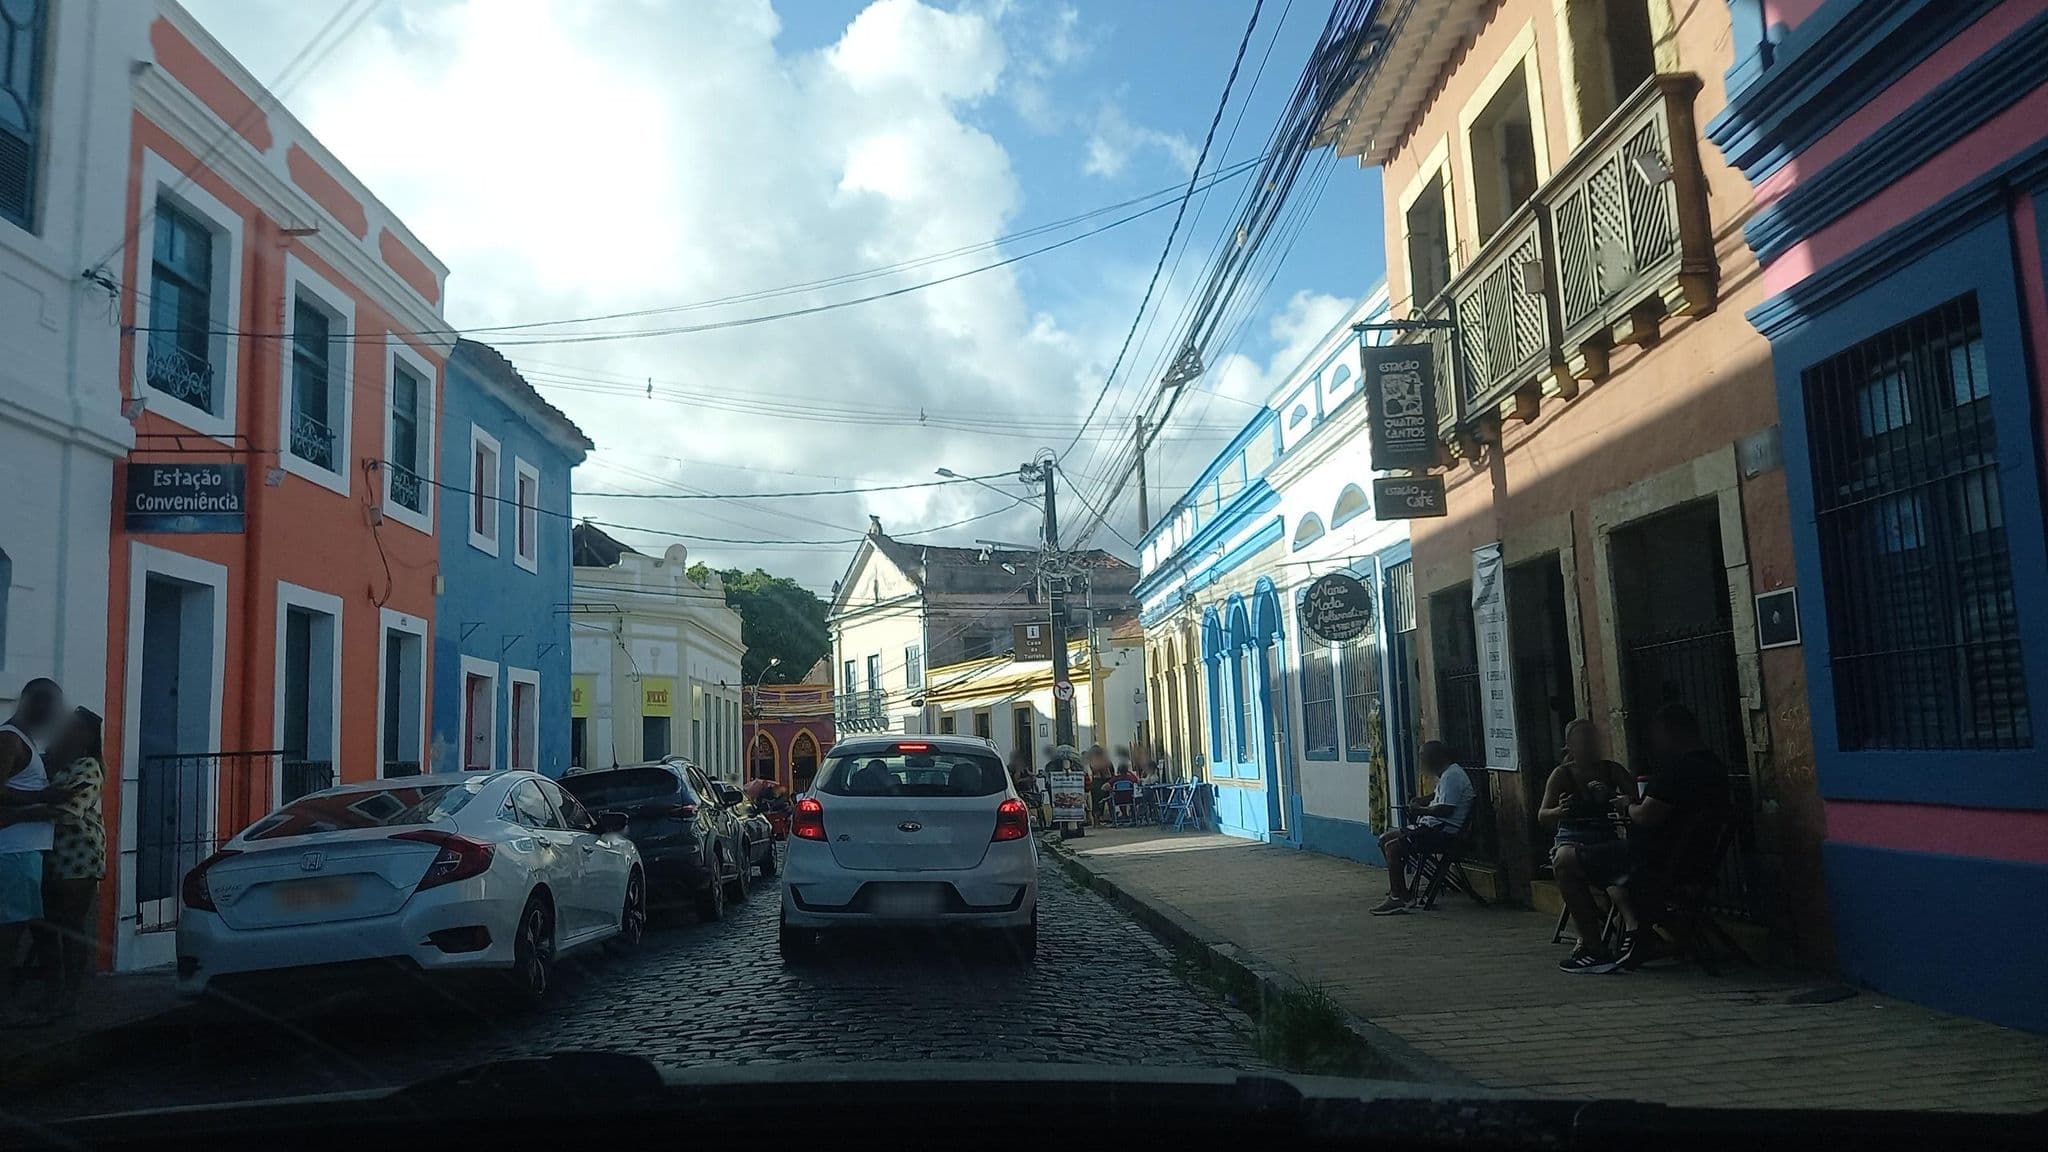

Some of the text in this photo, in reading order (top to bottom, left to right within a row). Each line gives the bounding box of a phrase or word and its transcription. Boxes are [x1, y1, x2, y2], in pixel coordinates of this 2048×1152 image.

[1384, 416, 1425, 428] QUATRO
[1385, 427, 1425, 439] CANTOS
[153, 467, 222, 490] Estação
[136, 492, 239, 511] Conveniência
[1307, 596, 1345, 618] Moda
